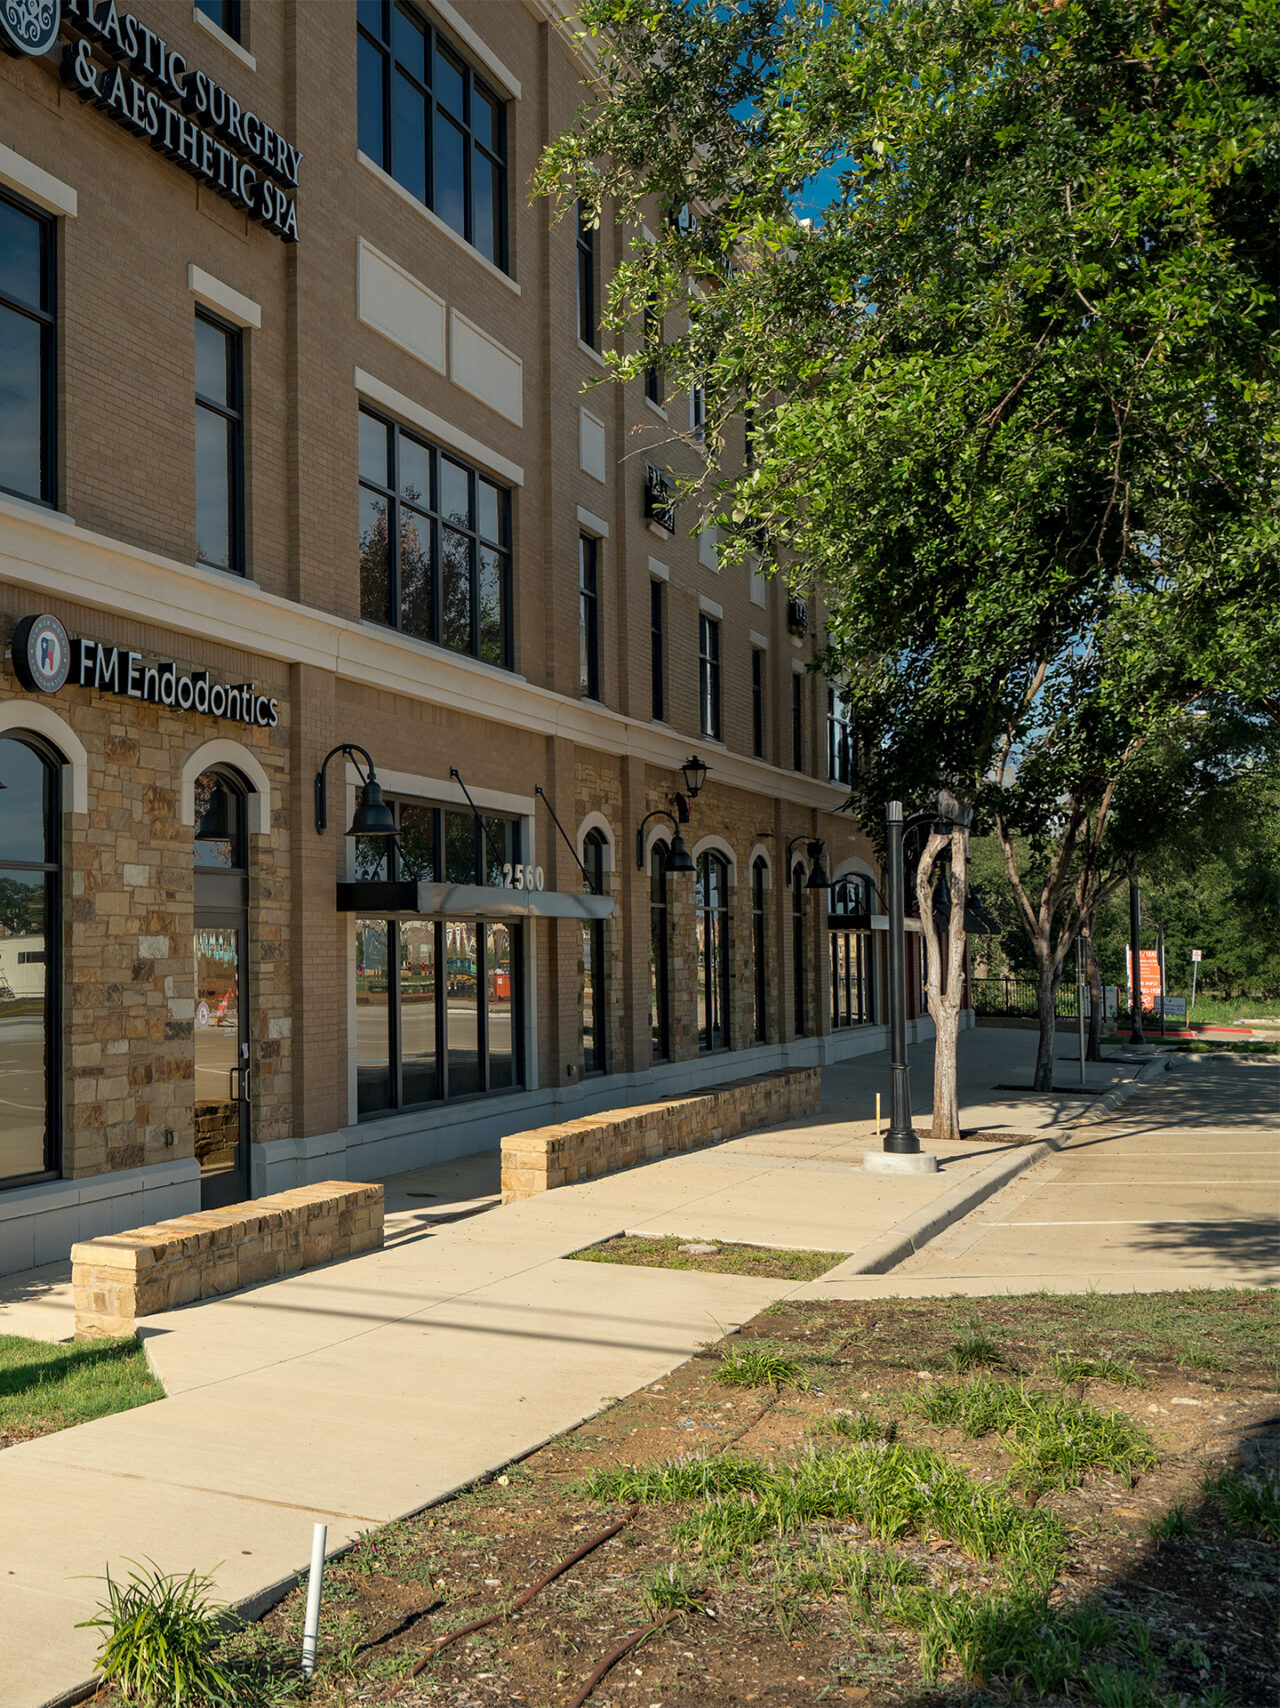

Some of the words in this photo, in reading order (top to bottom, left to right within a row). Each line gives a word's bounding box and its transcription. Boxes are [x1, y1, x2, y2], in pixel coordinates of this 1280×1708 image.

[69, 0, 187, 98] LASTIC
[195, 70, 305, 187] SURGERY
[75, 39, 102, 97] &
[108, 66, 256, 208] AESTHETIC
[261, 180, 301, 243] SPA
[80, 638, 119, 694] FM
[127, 650, 279, 728] Endodontics
[503, 863, 544, 892] 2560
